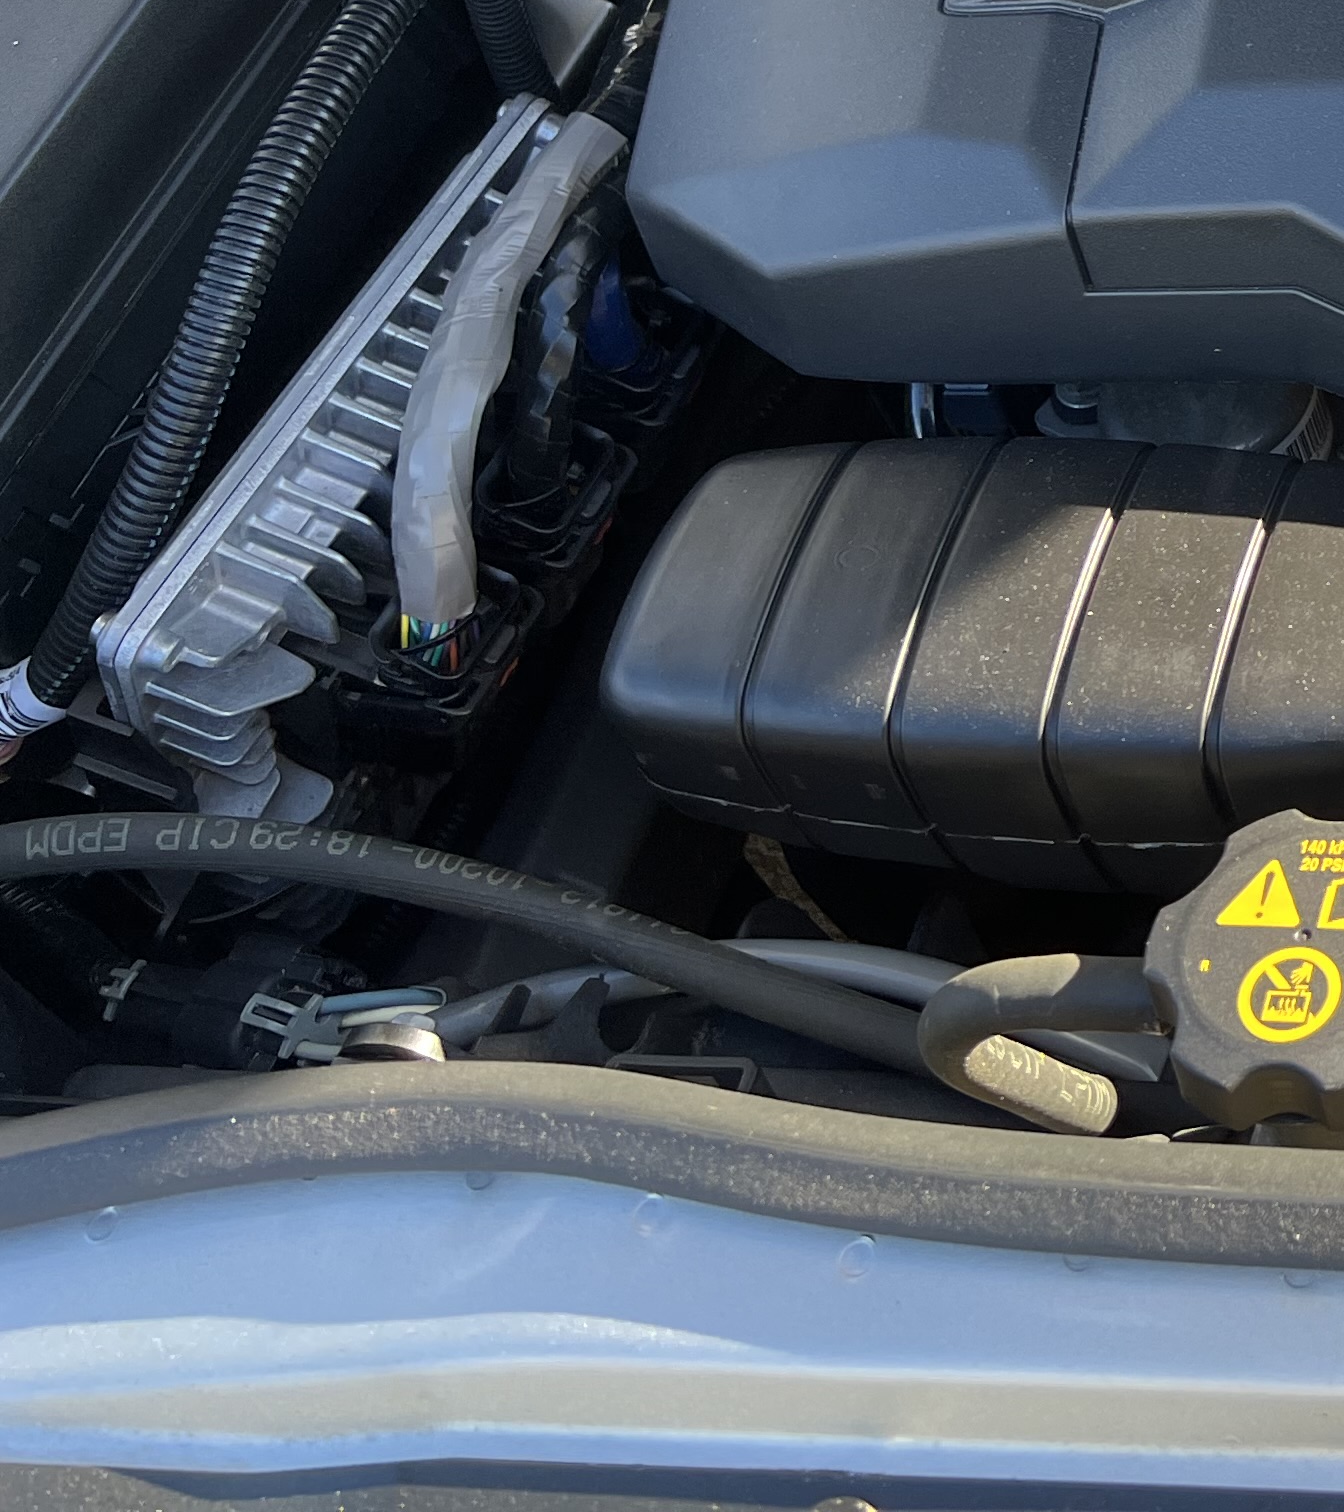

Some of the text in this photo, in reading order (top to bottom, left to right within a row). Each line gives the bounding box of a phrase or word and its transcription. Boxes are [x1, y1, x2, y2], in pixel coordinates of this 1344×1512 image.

[25, 816, 131, 861] EPDM
[155, 817, 239, 853] CIP
[1300, 839, 1328, 855] 140
[1299, 855, 1321, 872] 20
